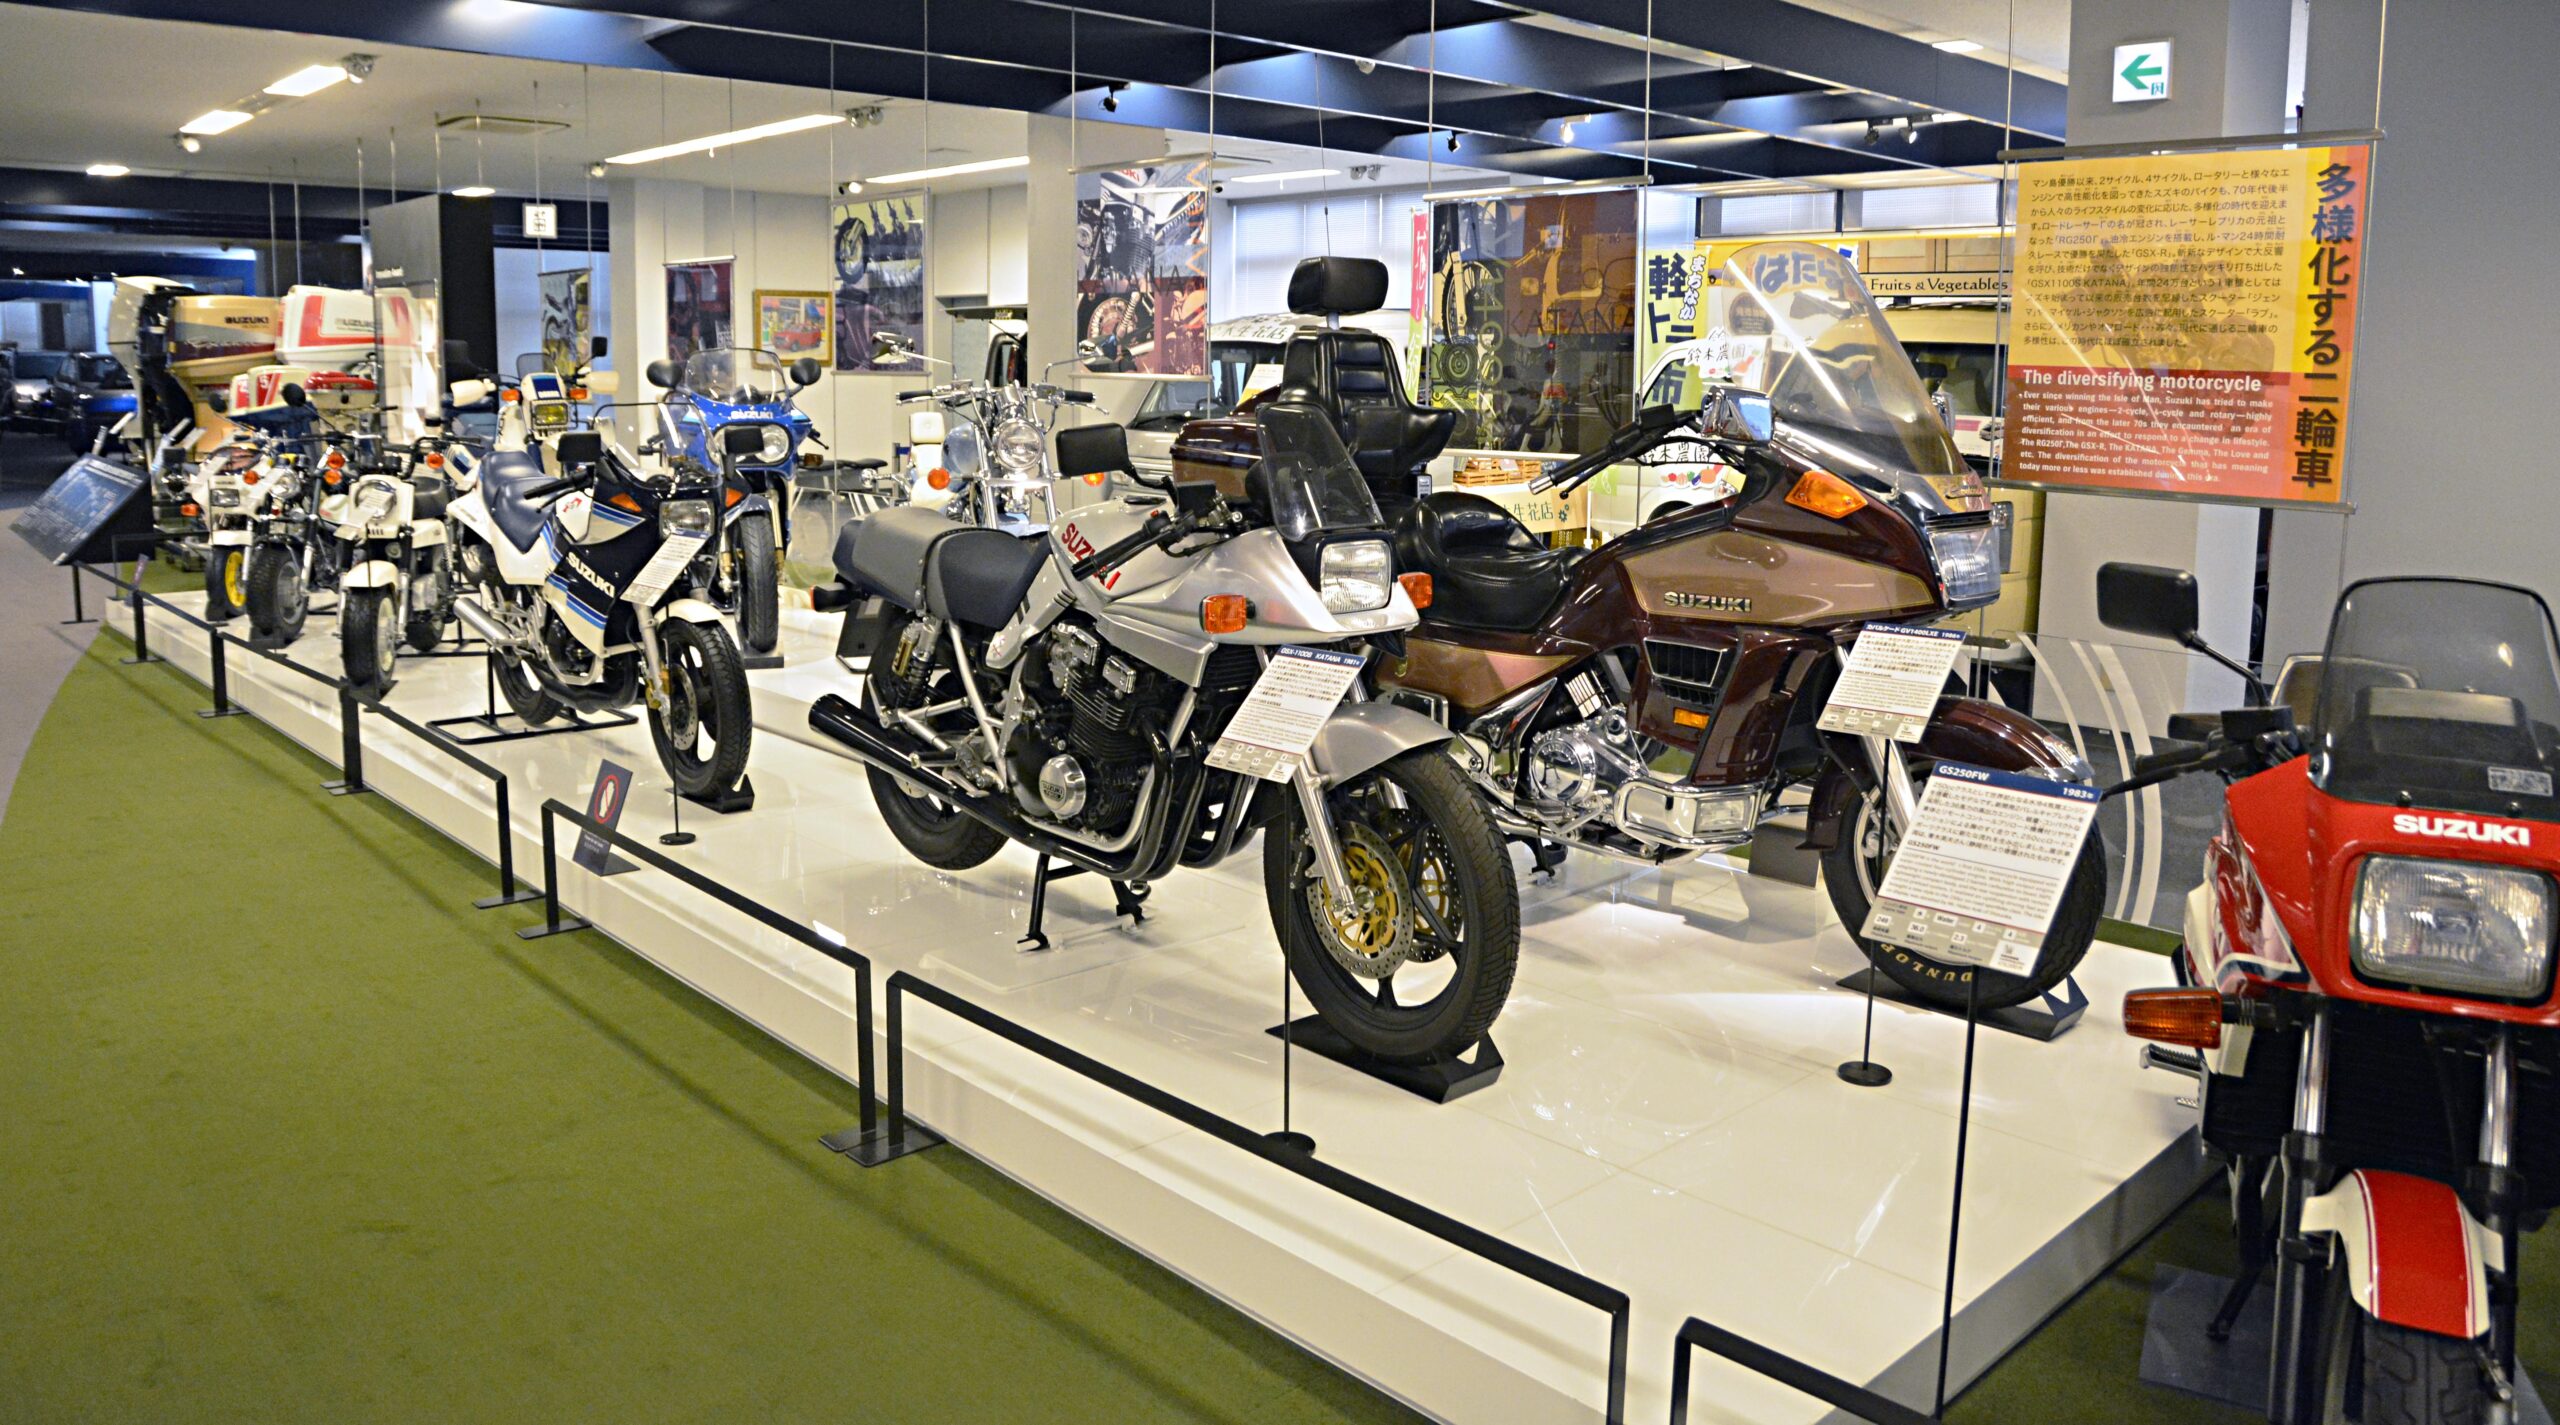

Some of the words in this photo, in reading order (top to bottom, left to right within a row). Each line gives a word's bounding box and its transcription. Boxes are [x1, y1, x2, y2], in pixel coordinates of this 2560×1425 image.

[1871, 279, 1911, 290] Fruits
[1927, 277, 2008, 293] Vegetables
[2292, 163, 2356, 487] 多様化する二輪車
[2023, 370, 2052, 385] The
[2057, 370, 2154, 391] diversifying
[2160, 375, 2261, 394] motorcycle
[2024, 391, 2040, 399] Ever
[2043, 392, 2062, 400] since
[2066, 393, 2095, 402] winning
[2099, 394, 2111, 402] the
[2131, 395, 2140, 403] of
[2165, 396, 2192, 405] Suzuki
[2196, 397, 2210, 405] has
[2214, 398, 2233, 406] tried
[2237, 399, 2246, 407] to
[2249, 399, 2273, 408] make
[731, 410, 773, 420] SUZUKI
[2023, 403, 2040, 411] their
[2189, 410, 2204, 418] and
[2096, 418, 2109, 426] the
[2112, 418, 2129, 426] later
[2022, 427, 2074, 436] diversification
[2124, 431, 2132, 439] to
[2038, 451, 2051, 459] The
[2055, 452, 2109, 462] diversification
[2109, 443, 2123, 451] The
[2161, 446, 2176, 454] The
[2214, 449, 2229, 457] The
[2231, 450, 2250, 458] Love
[2252, 451, 2269, 459] and
[2020, 462, 2040, 472] today
[2042, 464, 2061, 472] more
[2073, 465, 2088, 473] less
[566, 551, 617, 598] SUZUKI
[1664, 591, 1752, 613] SUZUKI
[1938, 765, 1990, 782] GS250FW
[2393, 814, 2531, 847] SUZUKI
[1881, 943, 1974, 983] DUNLOP
